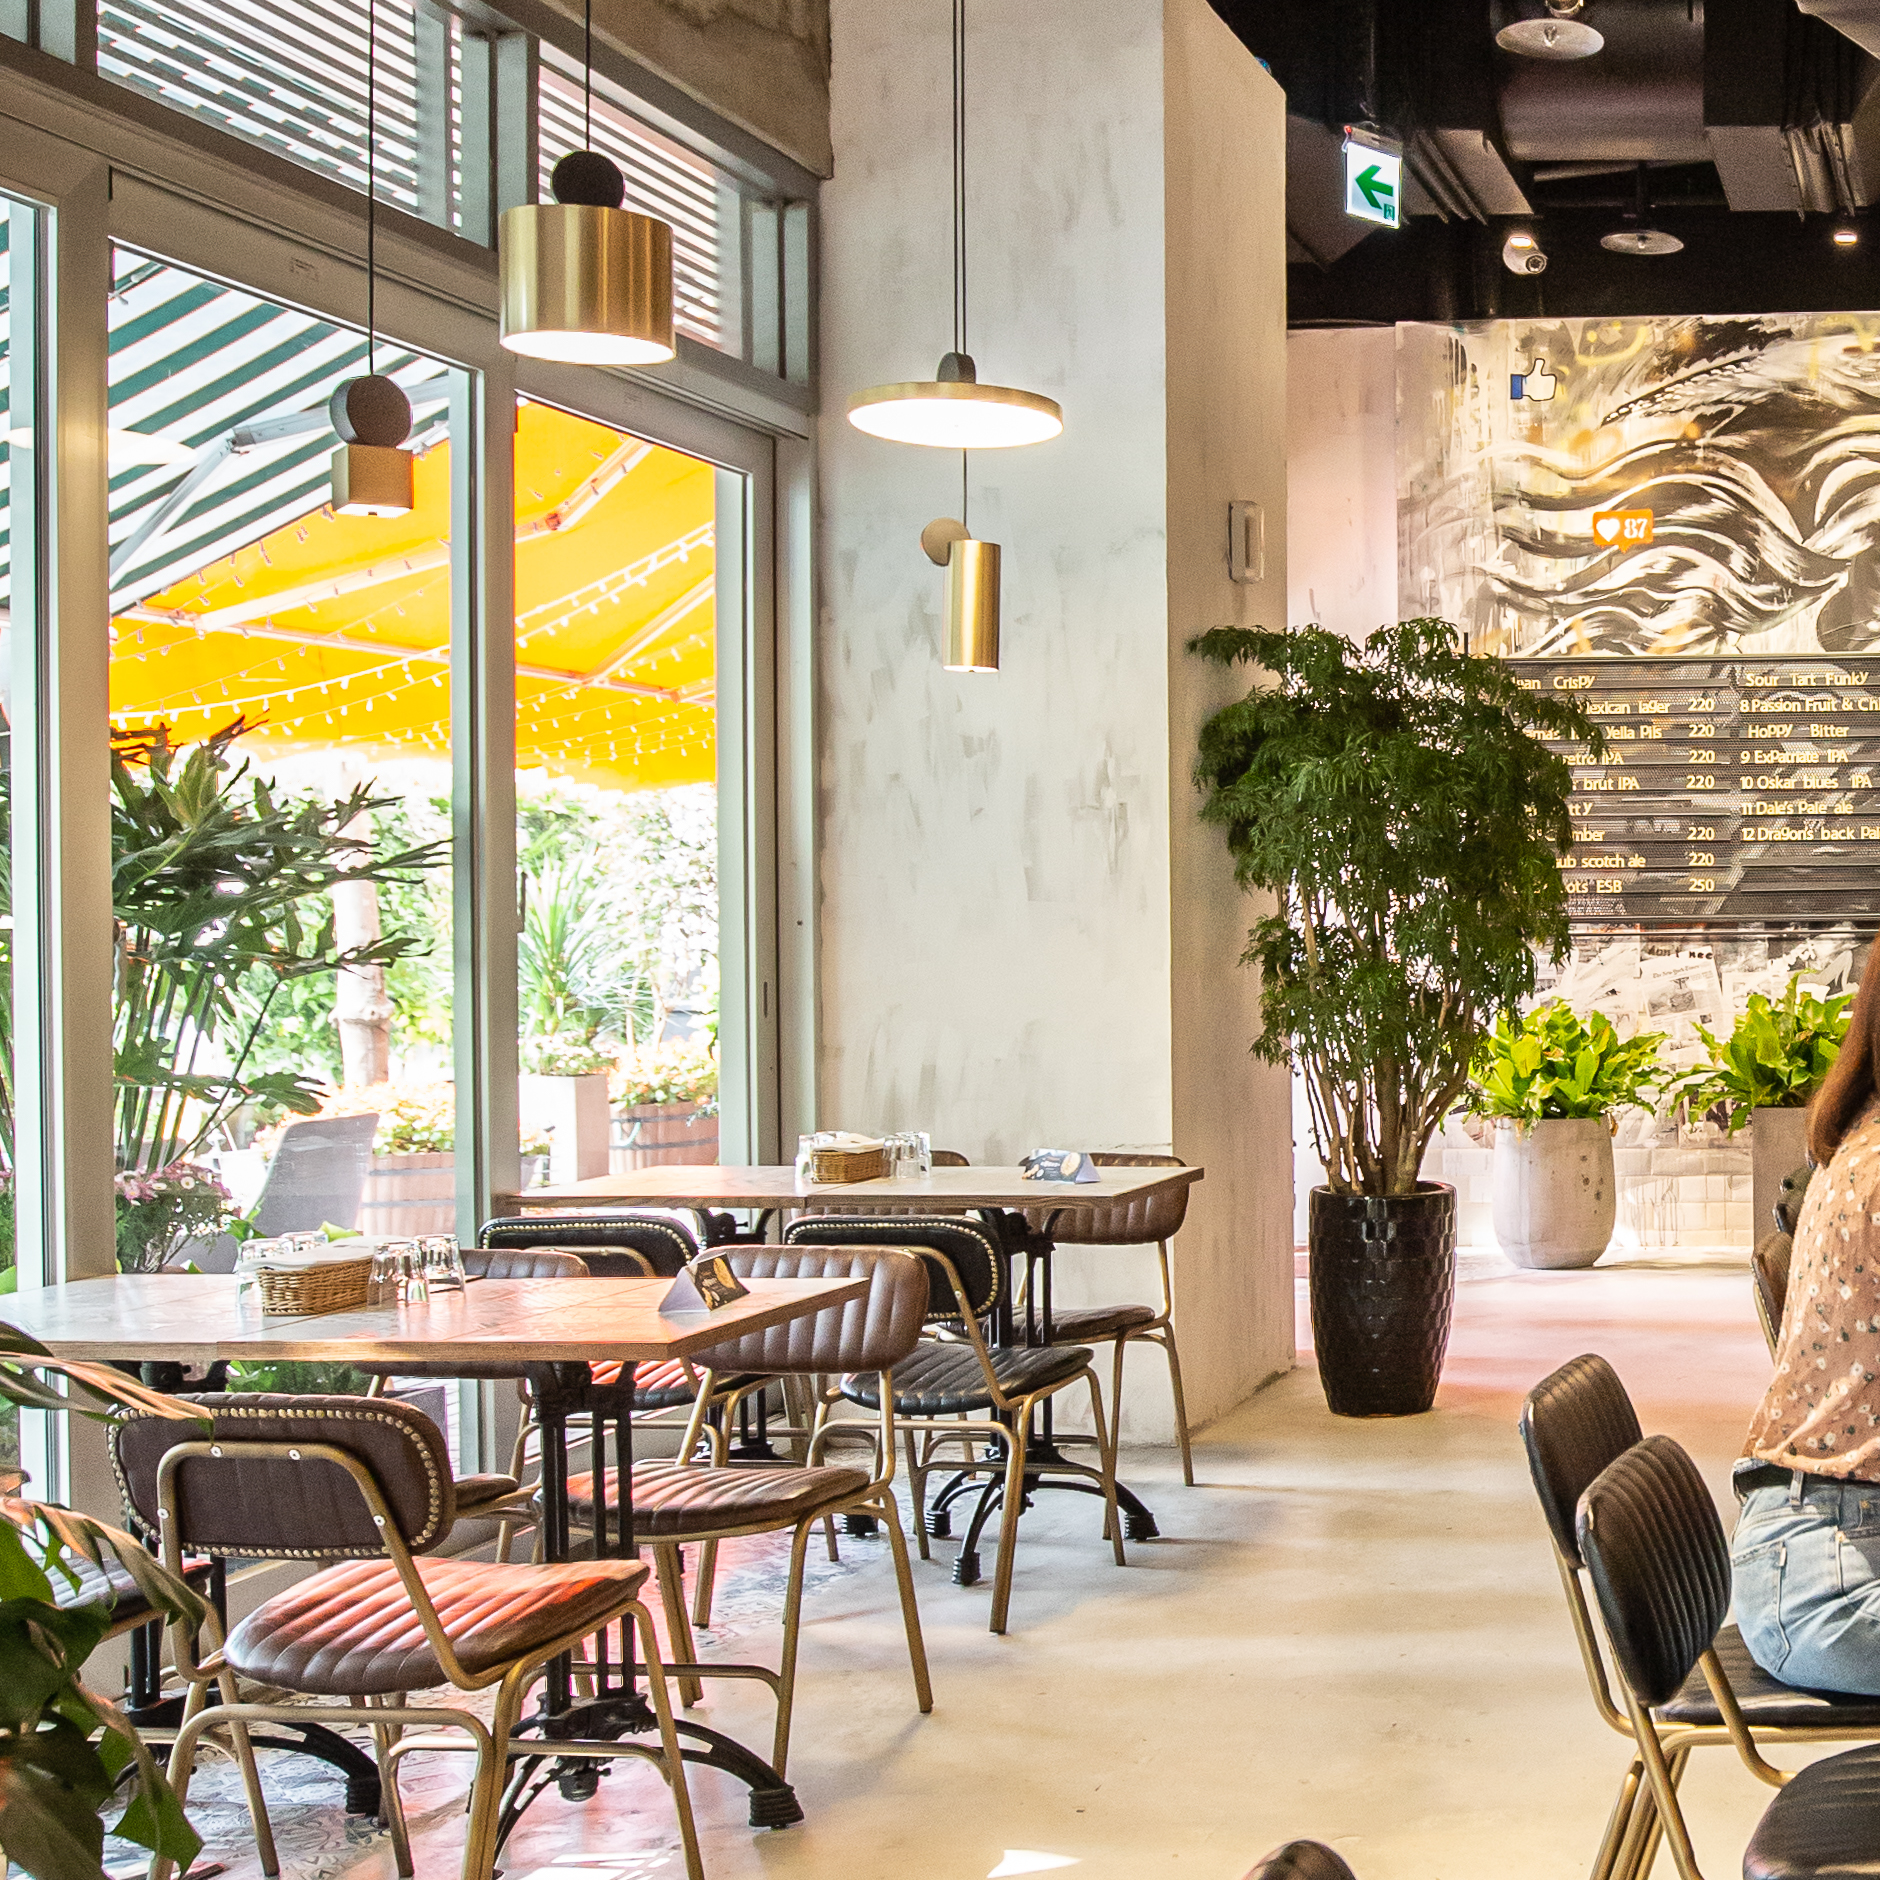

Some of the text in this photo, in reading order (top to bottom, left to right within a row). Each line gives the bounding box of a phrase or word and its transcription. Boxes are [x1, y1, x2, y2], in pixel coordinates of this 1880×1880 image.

[1623, 518, 1648, 539] 87
[1745, 671, 1870, 687] Sour Tart Funky
[1638, 699, 1671, 714] lager
[1687, 698, 1715, 712] 220
[1740, 699, 1750, 712] 8
[1752, 698, 1801, 712] Passion
[1805, 698, 1838, 712] Fruit
[1841, 697, 1854, 711] &
[1688, 724, 1715, 738] 220
[1747, 723, 1850, 738] Hoppy Bitter
[1688, 750, 1716, 764] 220
[1741, 750, 1751, 764] 9
[1827, 749, 1849, 763] IPA
[1583, 777, 1614, 790] brut
[1617, 776, 1640, 790] IPA
[1686, 775, 1715, 789] 220
[1740, 776, 1754, 790] 10
[1757, 774, 1798, 790] Oskar
[1803, 775, 1839, 790] blues
[1851, 774, 1873, 789] IPA
[1741, 801, 1754, 815] 11
[1756, 801, 1794, 815] Dale's
[1797, 801, 1828, 815] Pale
[1834, 801, 1854, 814] ale
[1687, 827, 1715, 841] 220
[1741, 827, 1756, 841] 12
[1821, 825, 1855, 840] back
[1581, 853, 1625, 869] scotch
[1628, 853, 1647, 868] ale
[1688, 853, 1715, 867] 220
[1596, 879, 1623, 893] ESB
[1688, 878, 1716, 892] 250
